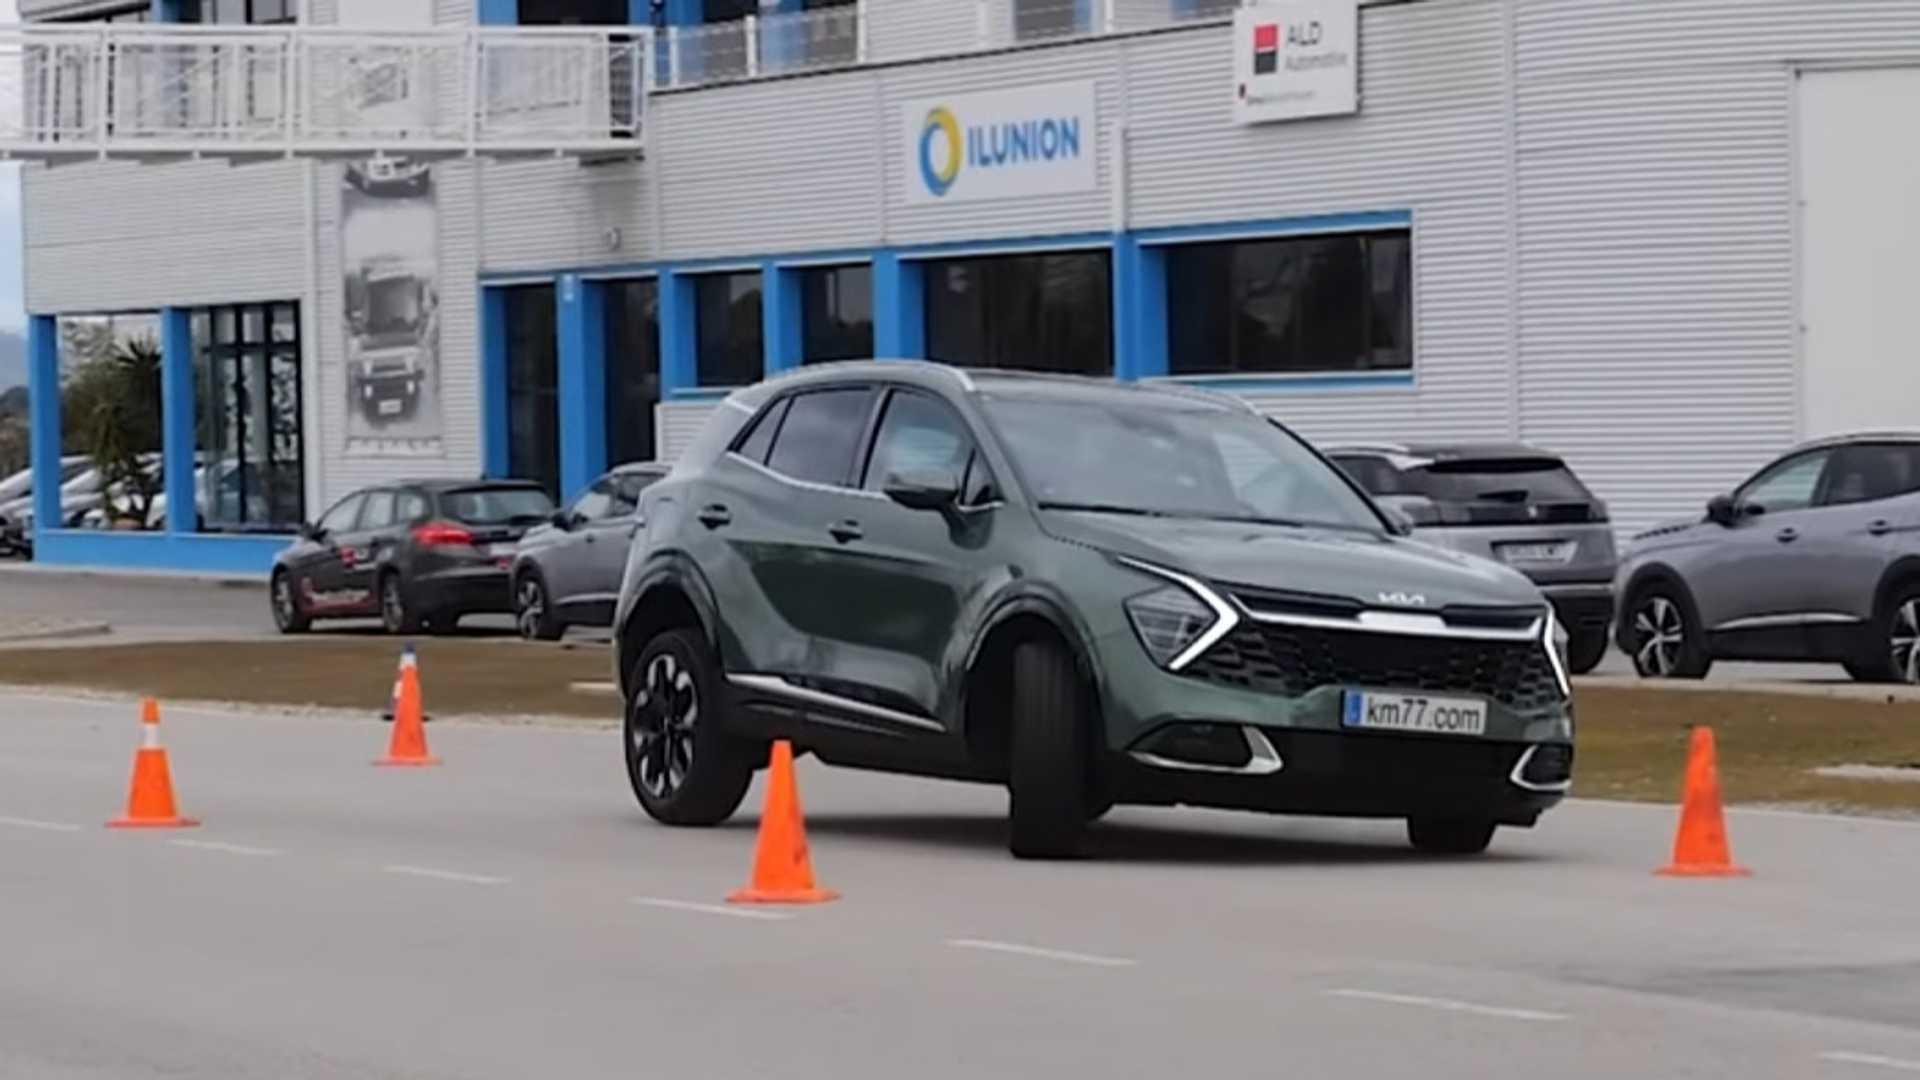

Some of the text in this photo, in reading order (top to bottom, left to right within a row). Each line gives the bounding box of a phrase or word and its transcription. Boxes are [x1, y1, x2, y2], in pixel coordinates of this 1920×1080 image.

[1286, 21, 1322, 46] ALD
[968, 116, 1080, 166] ILUNION
[1367, 696, 1480, 729] km77.com
